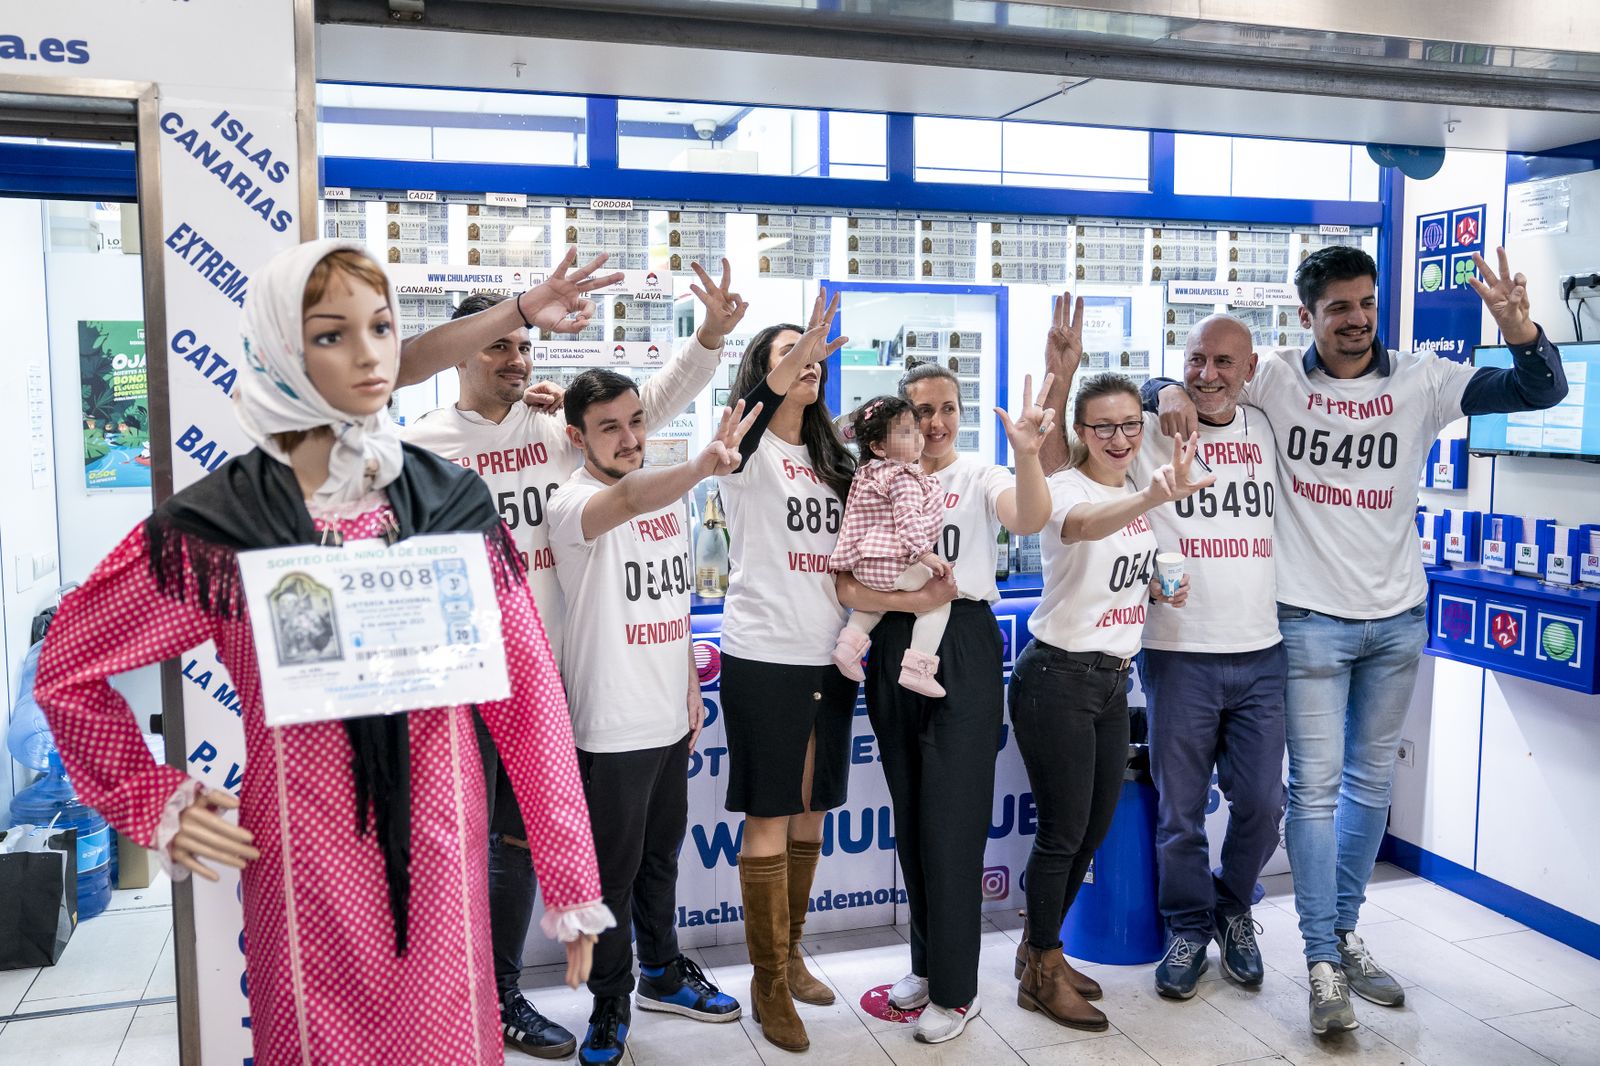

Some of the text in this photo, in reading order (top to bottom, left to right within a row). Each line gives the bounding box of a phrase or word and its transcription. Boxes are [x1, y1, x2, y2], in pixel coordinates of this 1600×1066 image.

[0, 34, 90, 65] a.es
[210, 110, 290, 184] ISLAS
[160, 111, 293, 233] CANARIAS
[592, 200, 632, 208] CORDOBA
[1321, 226, 1349, 234] VALENCIA
[427, 273, 503, 284] WWW.CHULAPUESTA.ES
[635, 292, 661, 300] ALAVA
[1174, 287, 1230, 297] WWW.CHULAPUESTA.ES
[1233, 299, 1265, 307] MALLORCA
[1413, 337, 1465, 354] Loterías y
[1327, 394, 1393, 420] PREMIO
[476, 442, 549, 475] PREMIO
[1203, 442, 1263, 466] PREMIO
[1287, 425, 1398, 469] 05490
[1293, 475, 1394, 509] VENDIDO AQUÍ
[267, 555, 322, 570] SORTEO
[326, 553, 350, 563] DEL
[398, 547, 414, 557] DE
[417, 545, 458, 556] ENERO
[1179, 538, 1249, 558] VENDIDO
[340, 568, 433, 592] 28008
[625, 618, 684, 645] VENDIDO
[182, 659, 212, 690] LA
[188, 740, 217, 774] P.
